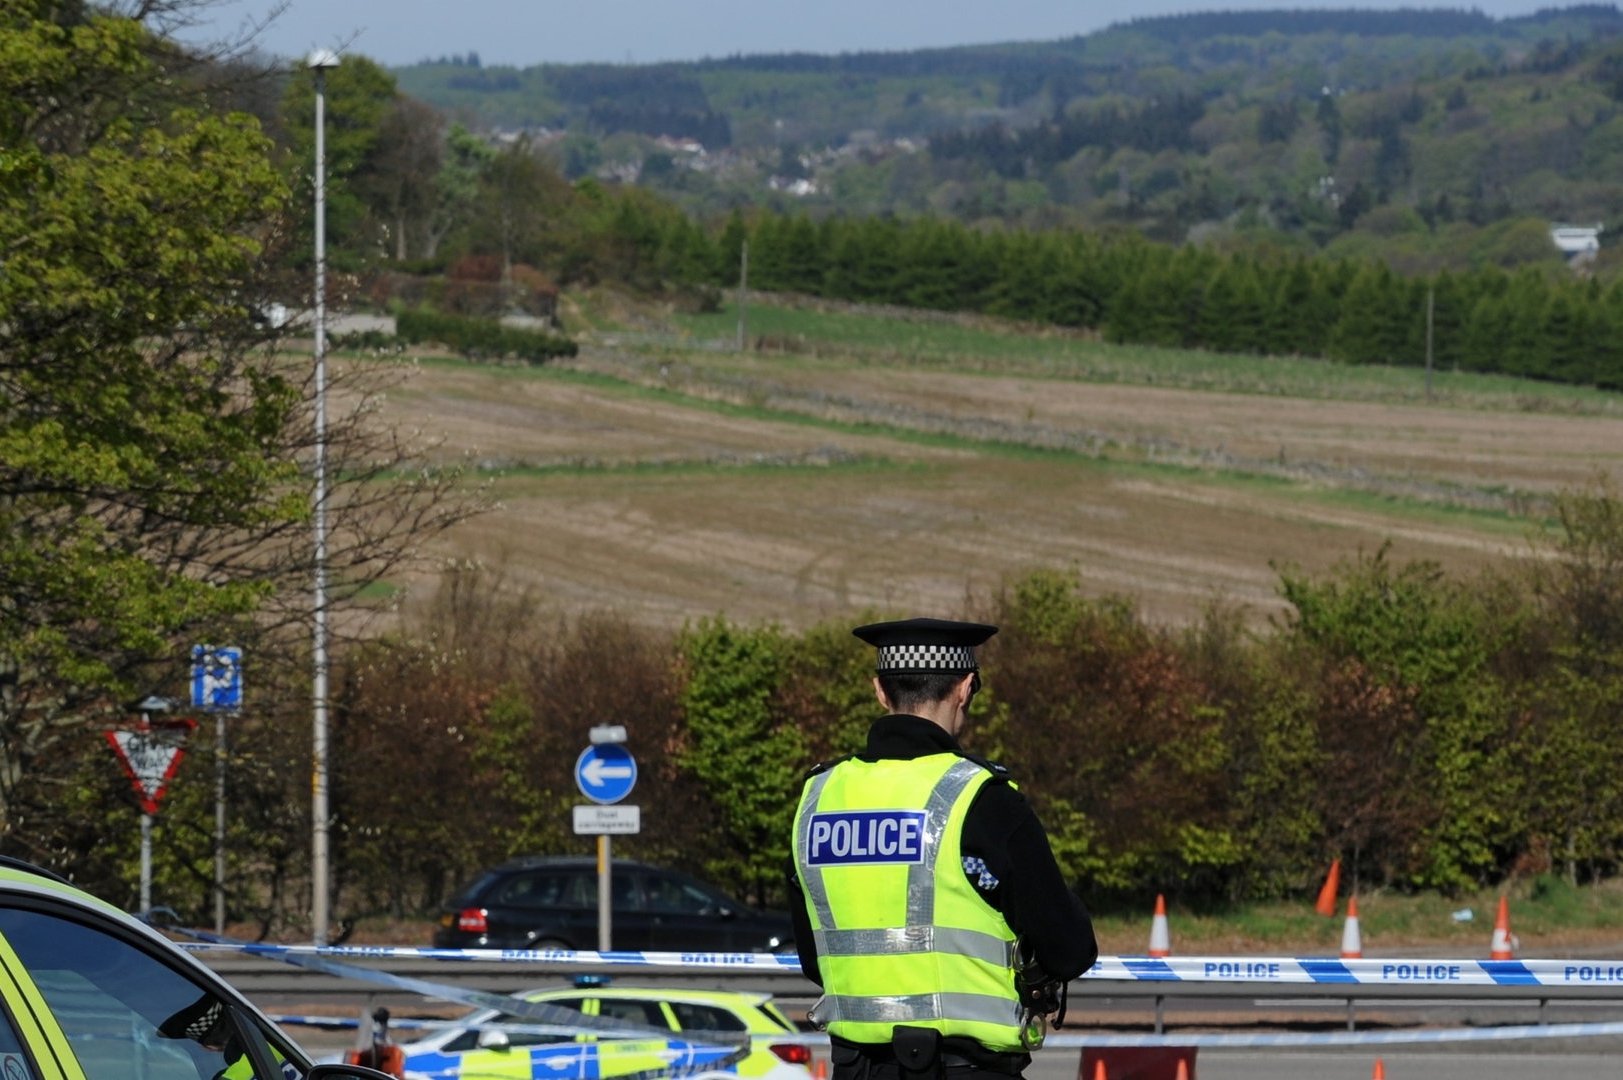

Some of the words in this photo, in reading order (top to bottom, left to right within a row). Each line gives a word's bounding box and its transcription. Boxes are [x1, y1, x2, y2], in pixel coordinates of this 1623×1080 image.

[203, 653, 234, 705] P
[811, 817, 919, 858] POLICE
[501, 949, 577, 963] POLICE
[680, 952, 755, 965] POLICE
[1204, 962, 1280, 979] POLICE
[1382, 964, 1461, 980] POLICE
[1564, 965, 1623, 982] POLIC
